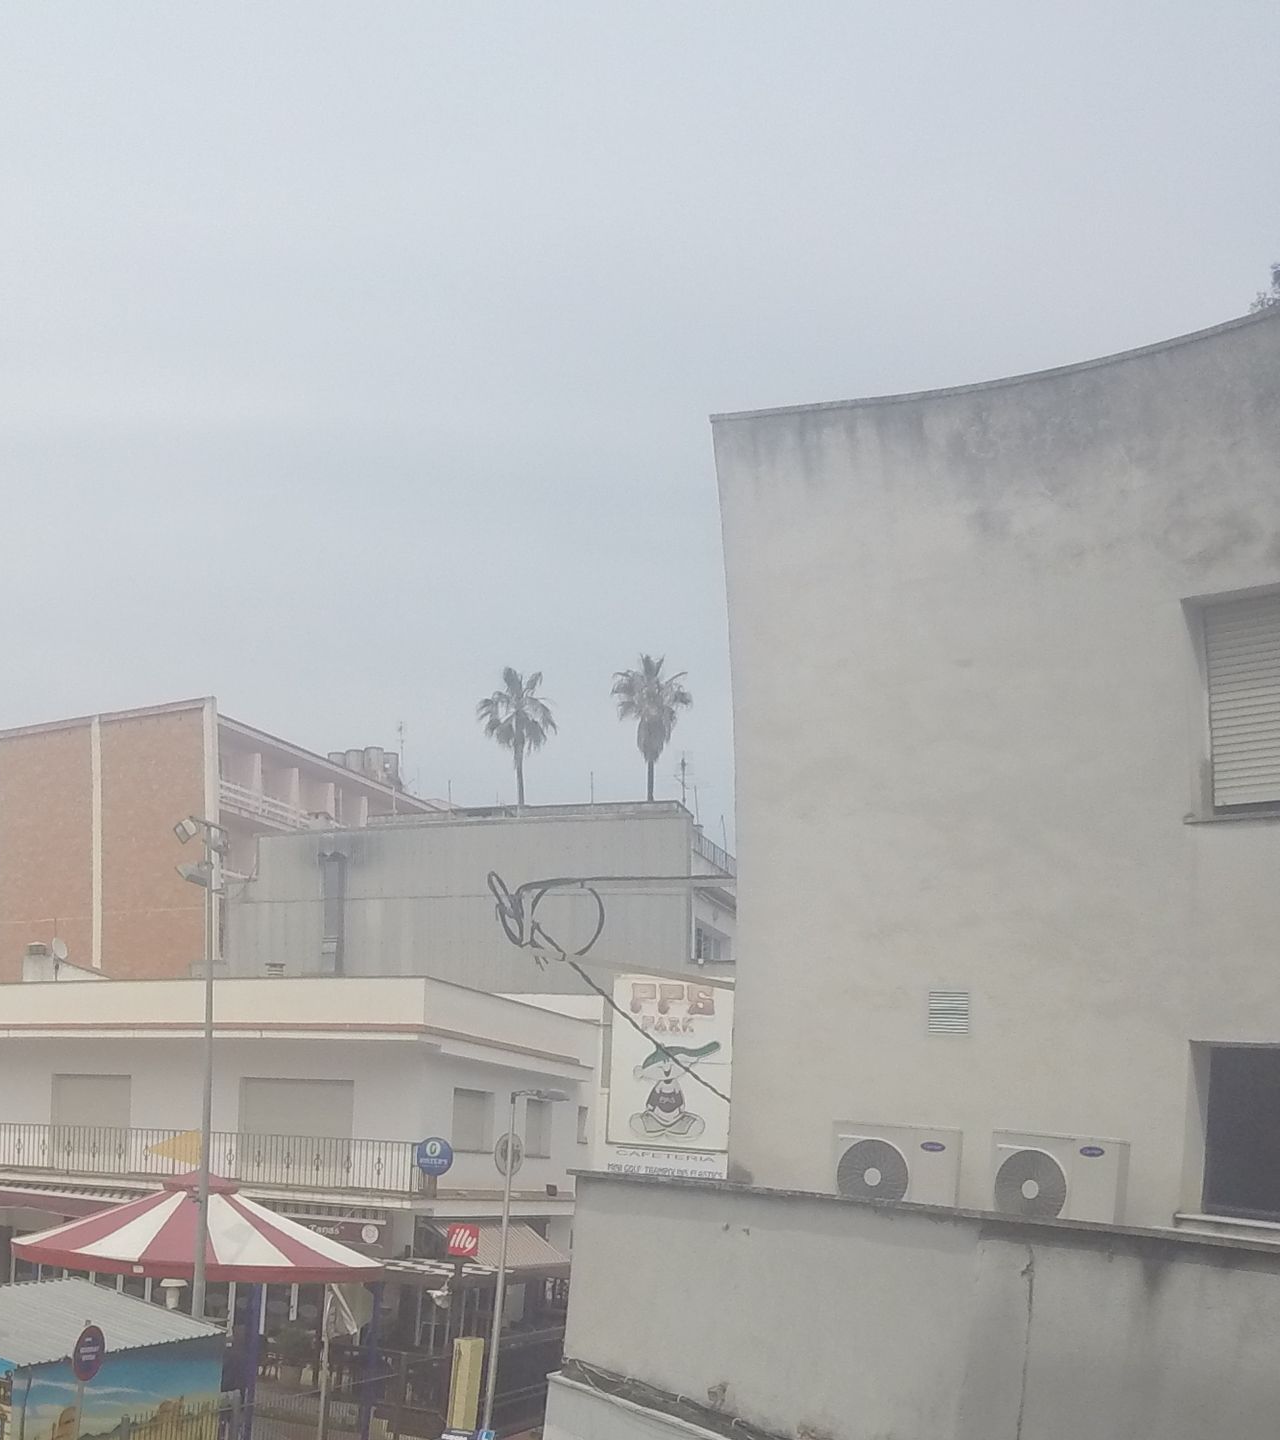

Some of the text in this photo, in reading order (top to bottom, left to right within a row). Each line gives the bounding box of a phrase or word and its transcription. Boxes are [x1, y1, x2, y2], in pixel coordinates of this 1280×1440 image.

[641, 1016, 695, 1033] PARK
[616, 1150, 715, 1162] CAFETERIA
[450, 1228, 478, 1254] illy
